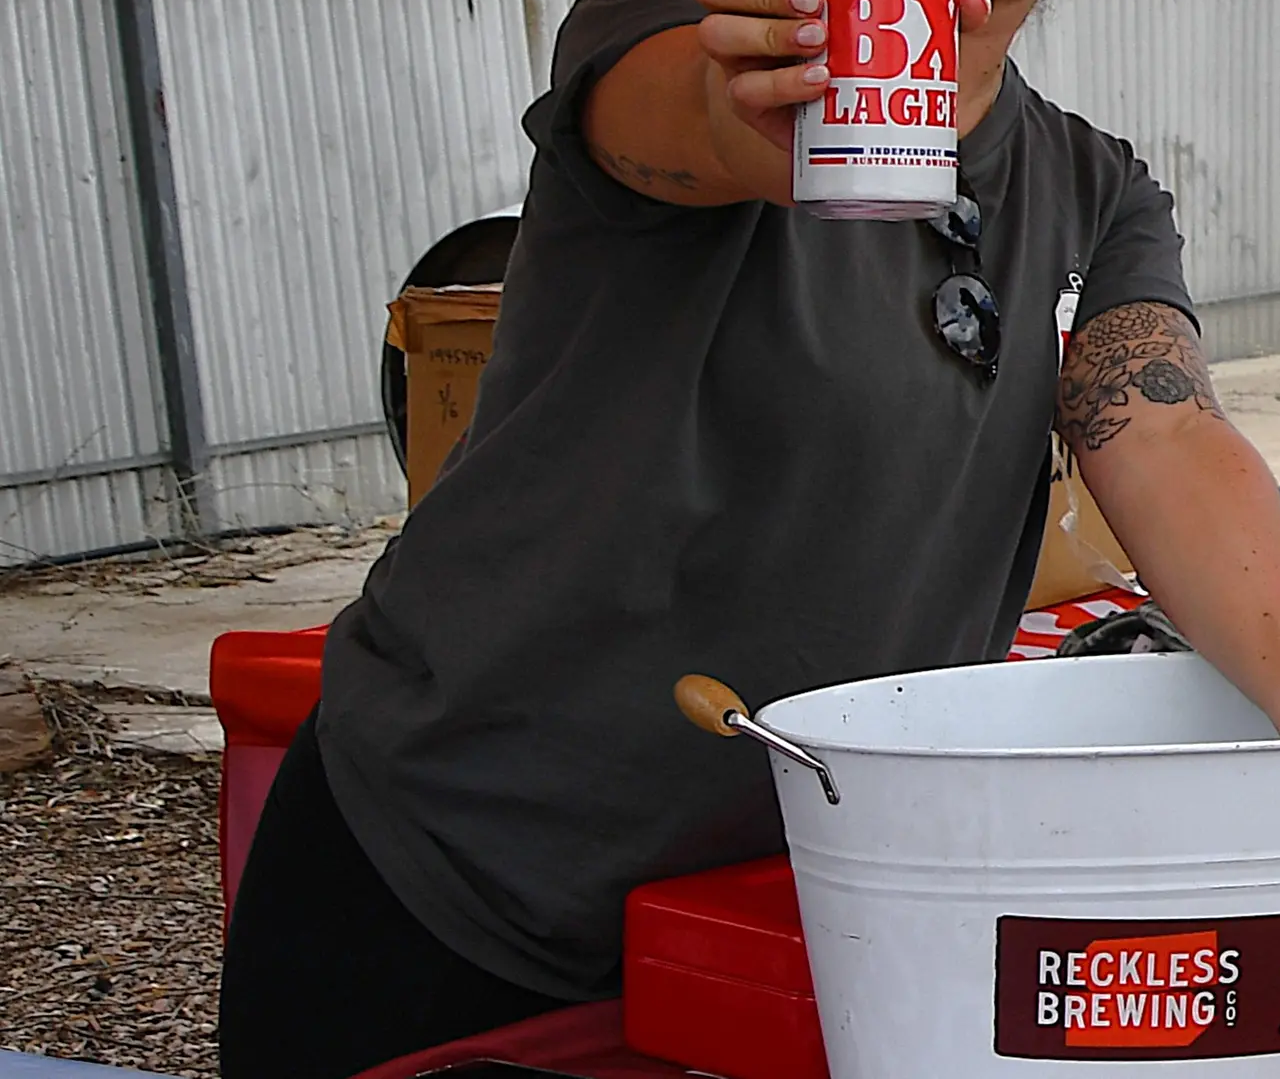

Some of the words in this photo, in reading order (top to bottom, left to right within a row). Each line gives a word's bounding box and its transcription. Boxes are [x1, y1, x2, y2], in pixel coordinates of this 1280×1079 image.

[851, 156, 922, 167] AUSTRALIAN
[869, 146, 943, 157] INDEPENDENT
[1039, 948, 1240, 988] RECKLESS
[1037, 990, 1216, 1029] BREWING
